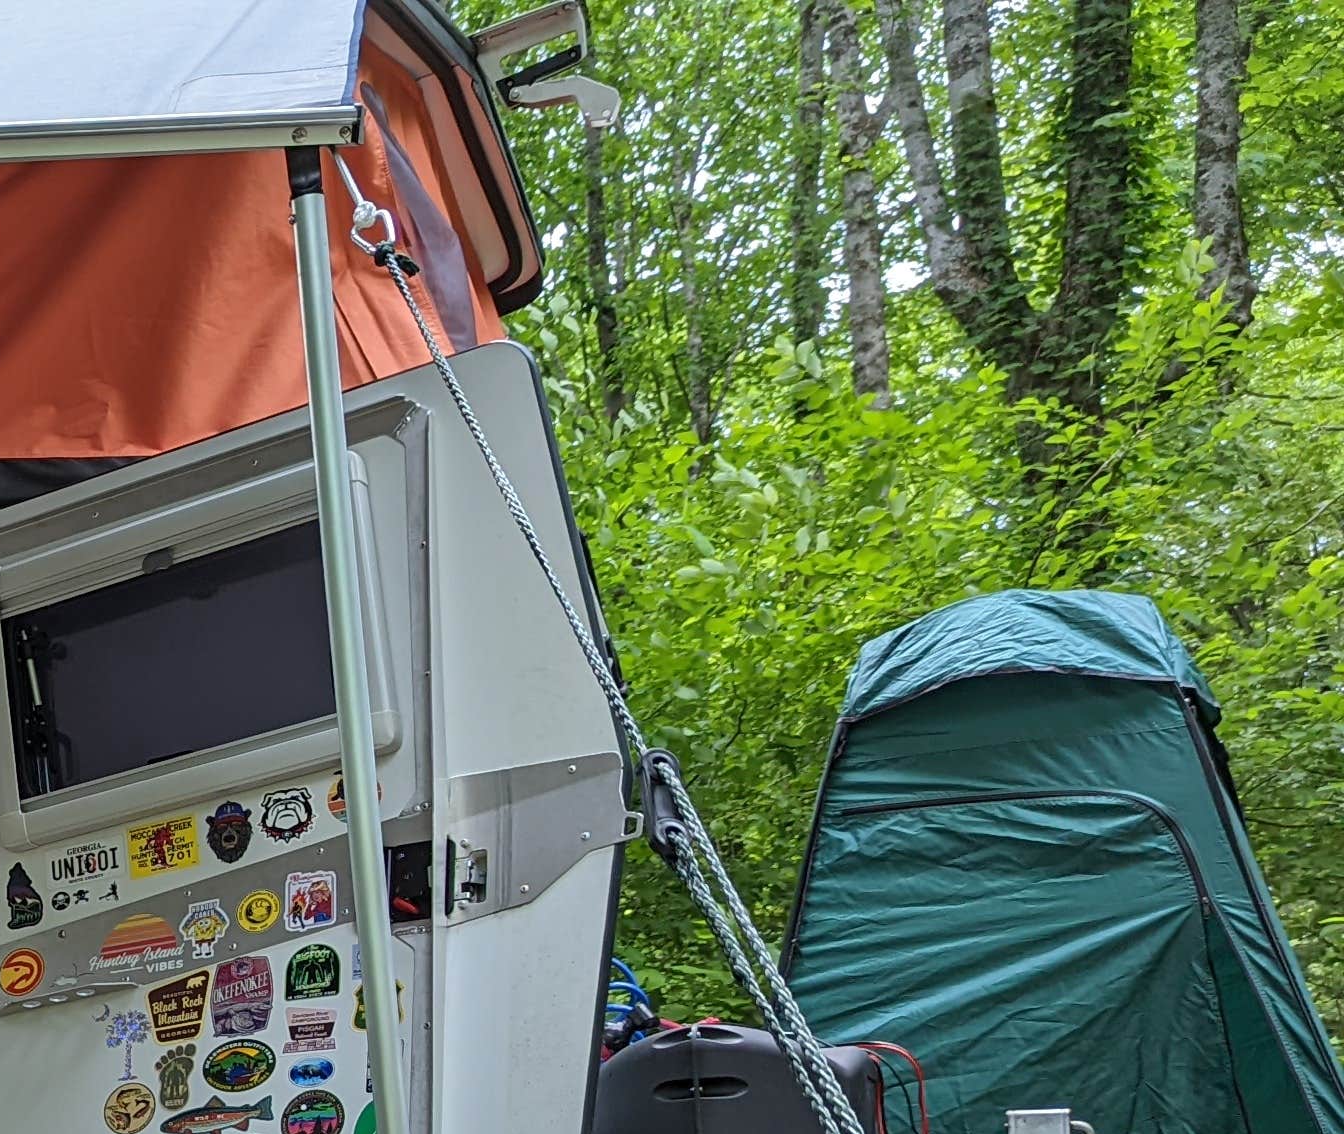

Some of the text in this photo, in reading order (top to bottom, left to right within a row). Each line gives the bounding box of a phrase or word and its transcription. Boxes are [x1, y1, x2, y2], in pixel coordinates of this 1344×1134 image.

[169, 819, 193, 832] CREEK
[66, 842, 102, 856] GEORGIA
[88, 943, 185, 972] Hunting Island
[145, 959, 184, 973] VIBES
[213, 970, 269, 1003] OKEFENOKEE
[152, 993, 204, 1015] Black Rock
[158, 1008, 199, 1026] Mountain
[297, 1024, 325, 1033] PISGAH
